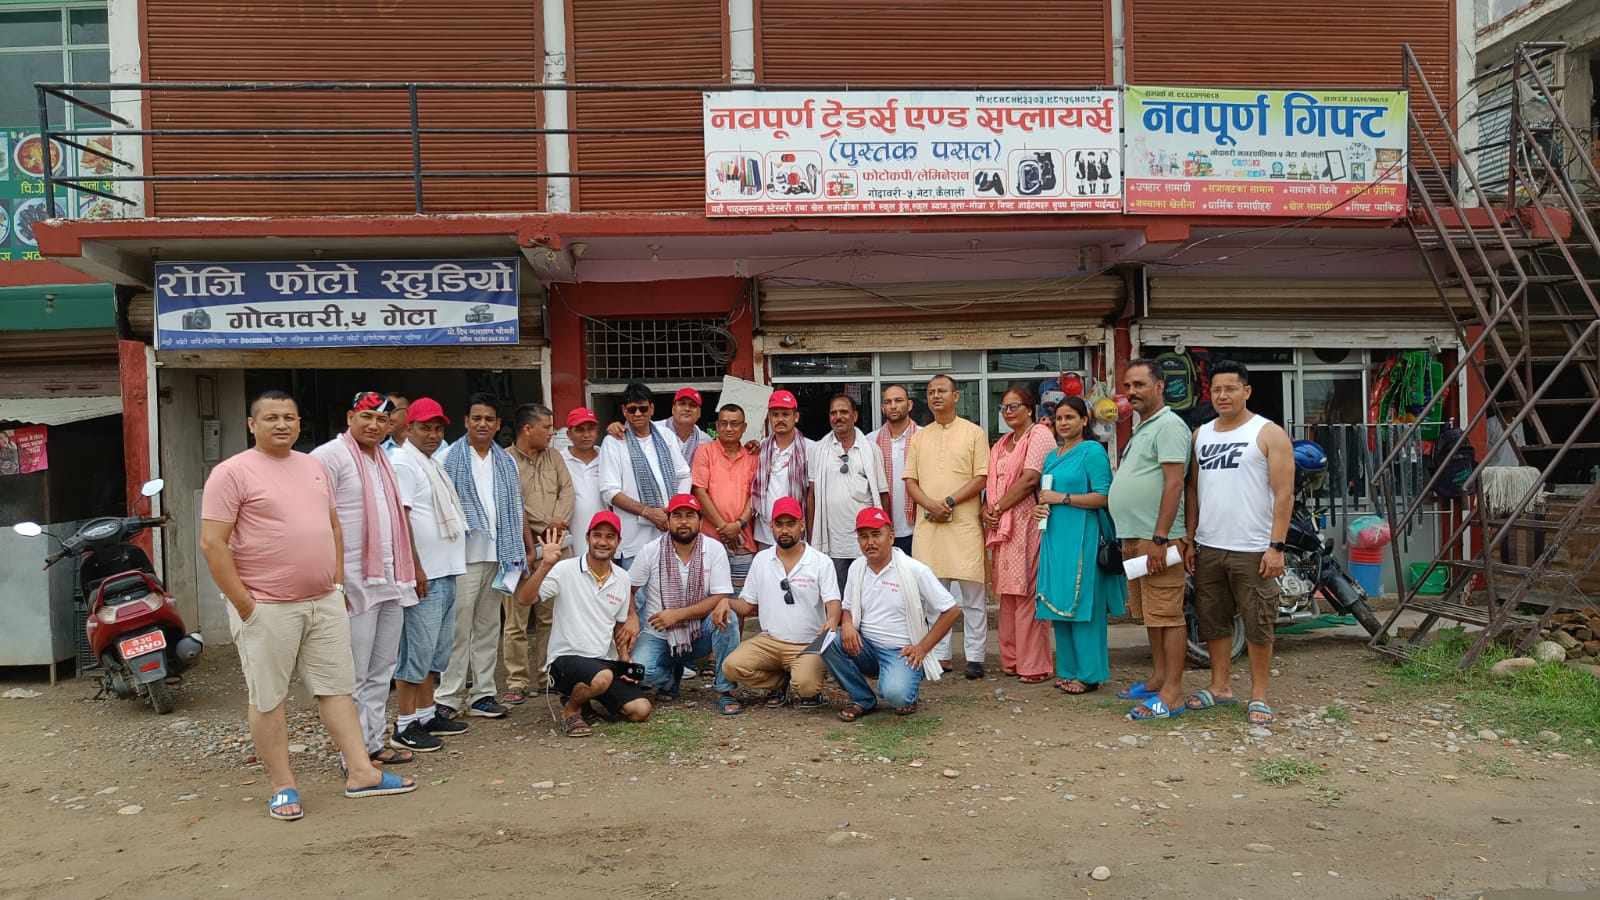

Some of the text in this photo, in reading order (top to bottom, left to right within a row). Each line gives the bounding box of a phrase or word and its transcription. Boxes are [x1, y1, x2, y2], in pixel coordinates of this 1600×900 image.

[710, 98, 1114, 140] नवपूर्ण ट्रेडर्स एण्ड सप्लायर्स
[1142, 92, 1389, 146] नवपूर्ण गिफ्ट
[829, 139, 1002, 167] (पुस्तक पसल)
[158, 262, 515, 299] रोजि फोटो स्टुडियो
[380, 304, 438, 327] गेटा
